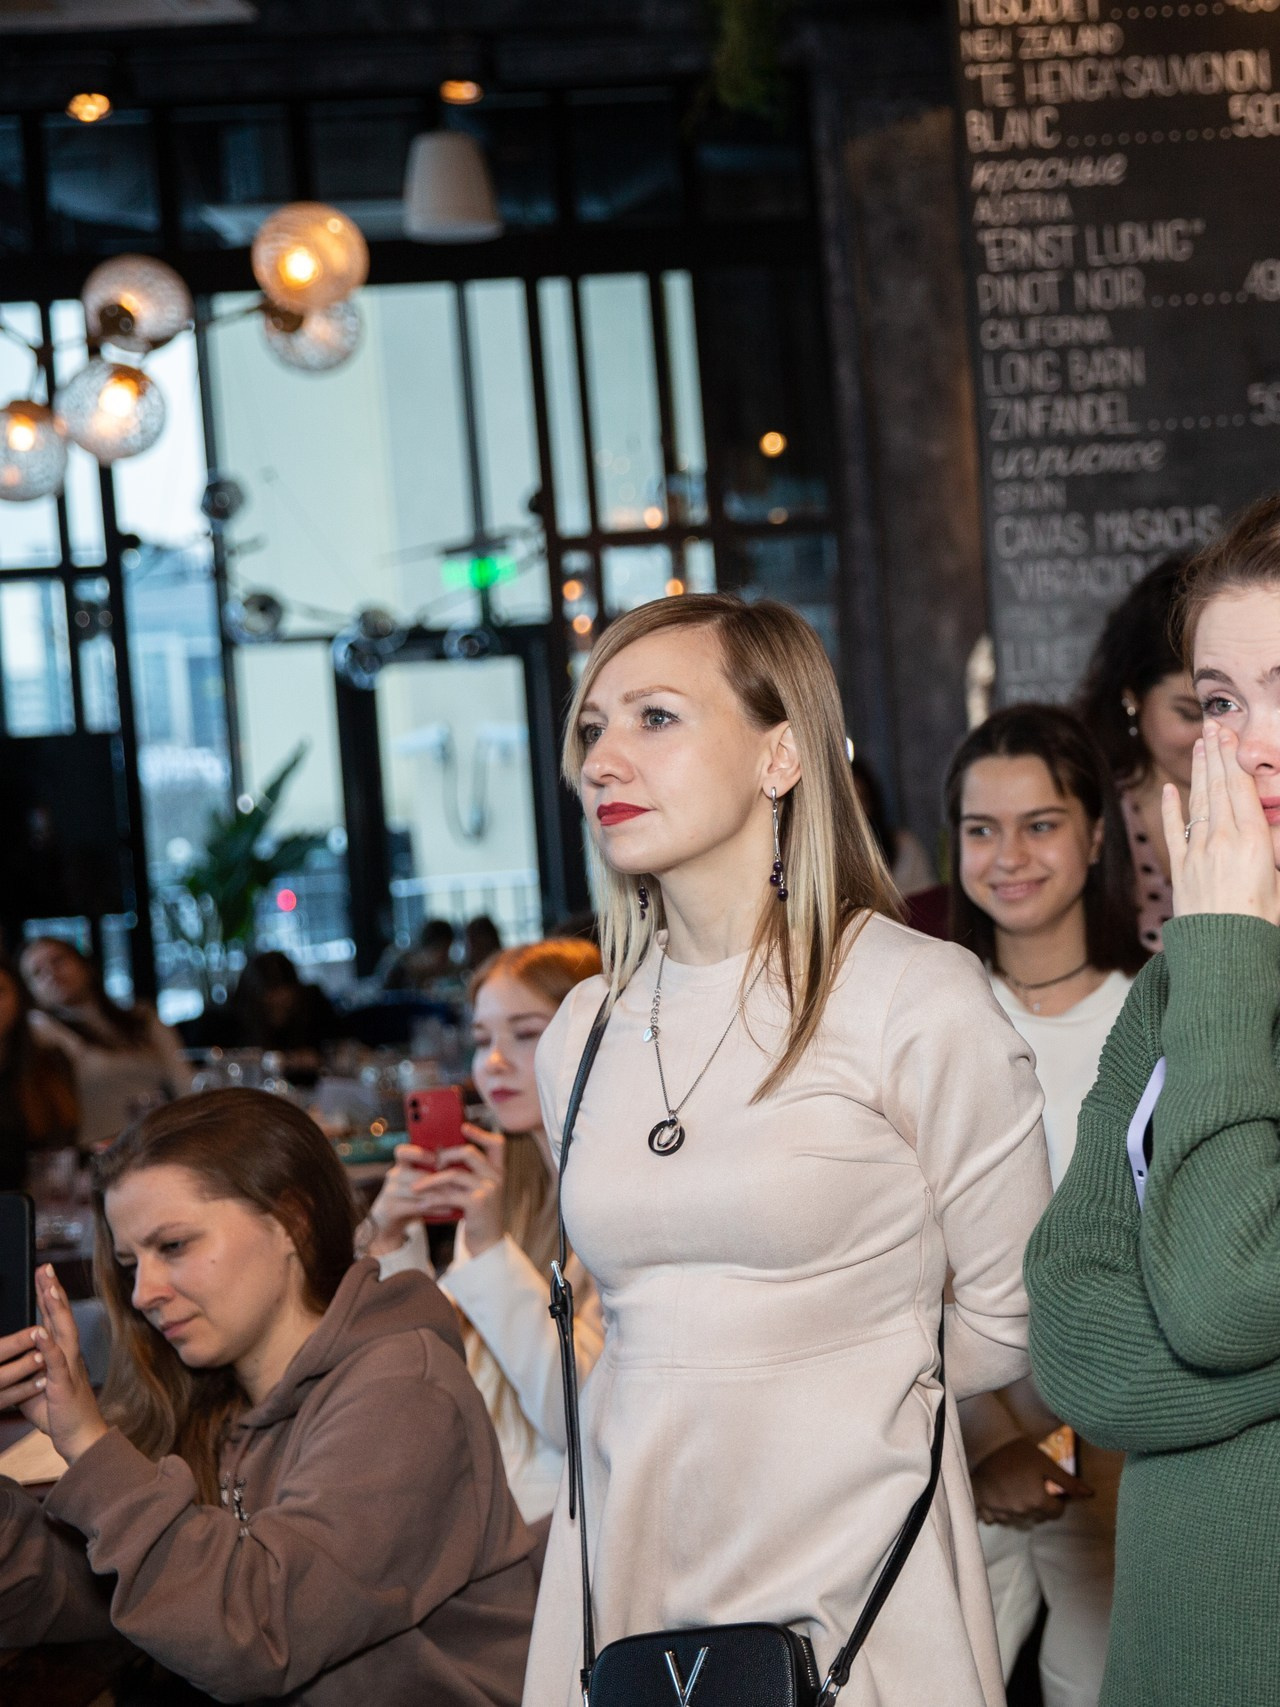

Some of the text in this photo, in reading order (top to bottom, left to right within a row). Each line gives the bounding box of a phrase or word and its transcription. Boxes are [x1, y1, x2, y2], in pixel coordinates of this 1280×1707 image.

[960, 22, 1125, 61] NEW ZEALAND
[965, 105, 1062, 153] BLANC
[972, 193, 1075, 227] AUSTRIA
[976, 269, 1065, 317] PINOT
[1073, 265, 1146, 311] NOIR
[979, 314, 1113, 350] CALIFORNIA
[982, 347, 1146, 397] LONG BARN
[988, 391, 1141, 442] ZINFANDEL
[993, 510, 1090, 559] CAVAS
